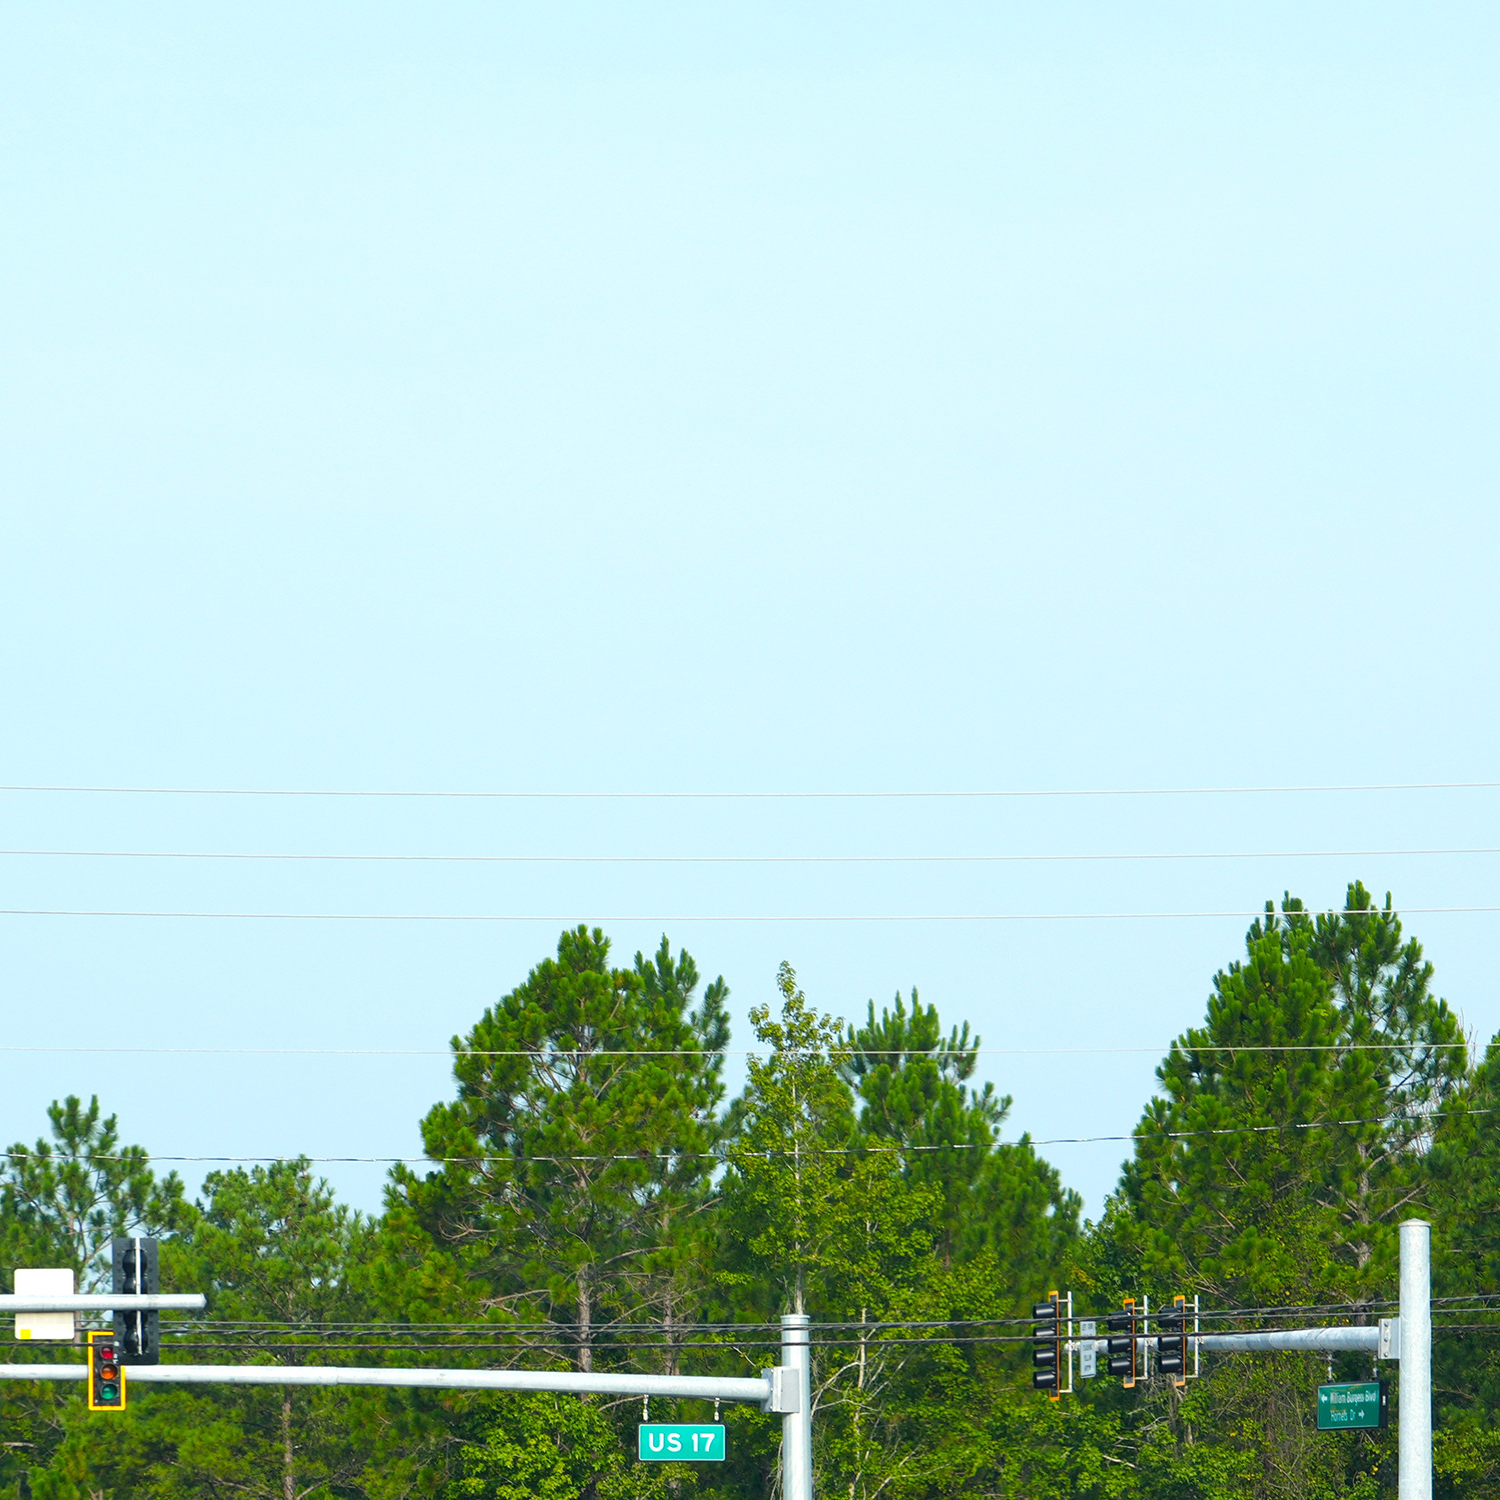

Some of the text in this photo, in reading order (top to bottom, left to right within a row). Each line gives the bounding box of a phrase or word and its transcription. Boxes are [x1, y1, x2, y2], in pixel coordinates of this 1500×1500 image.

[1364, 1389, 1377, 1402] Blvd
[1349, 1408, 1356, 1421] Dr
[648, 1432, 716, 1452] US 17
